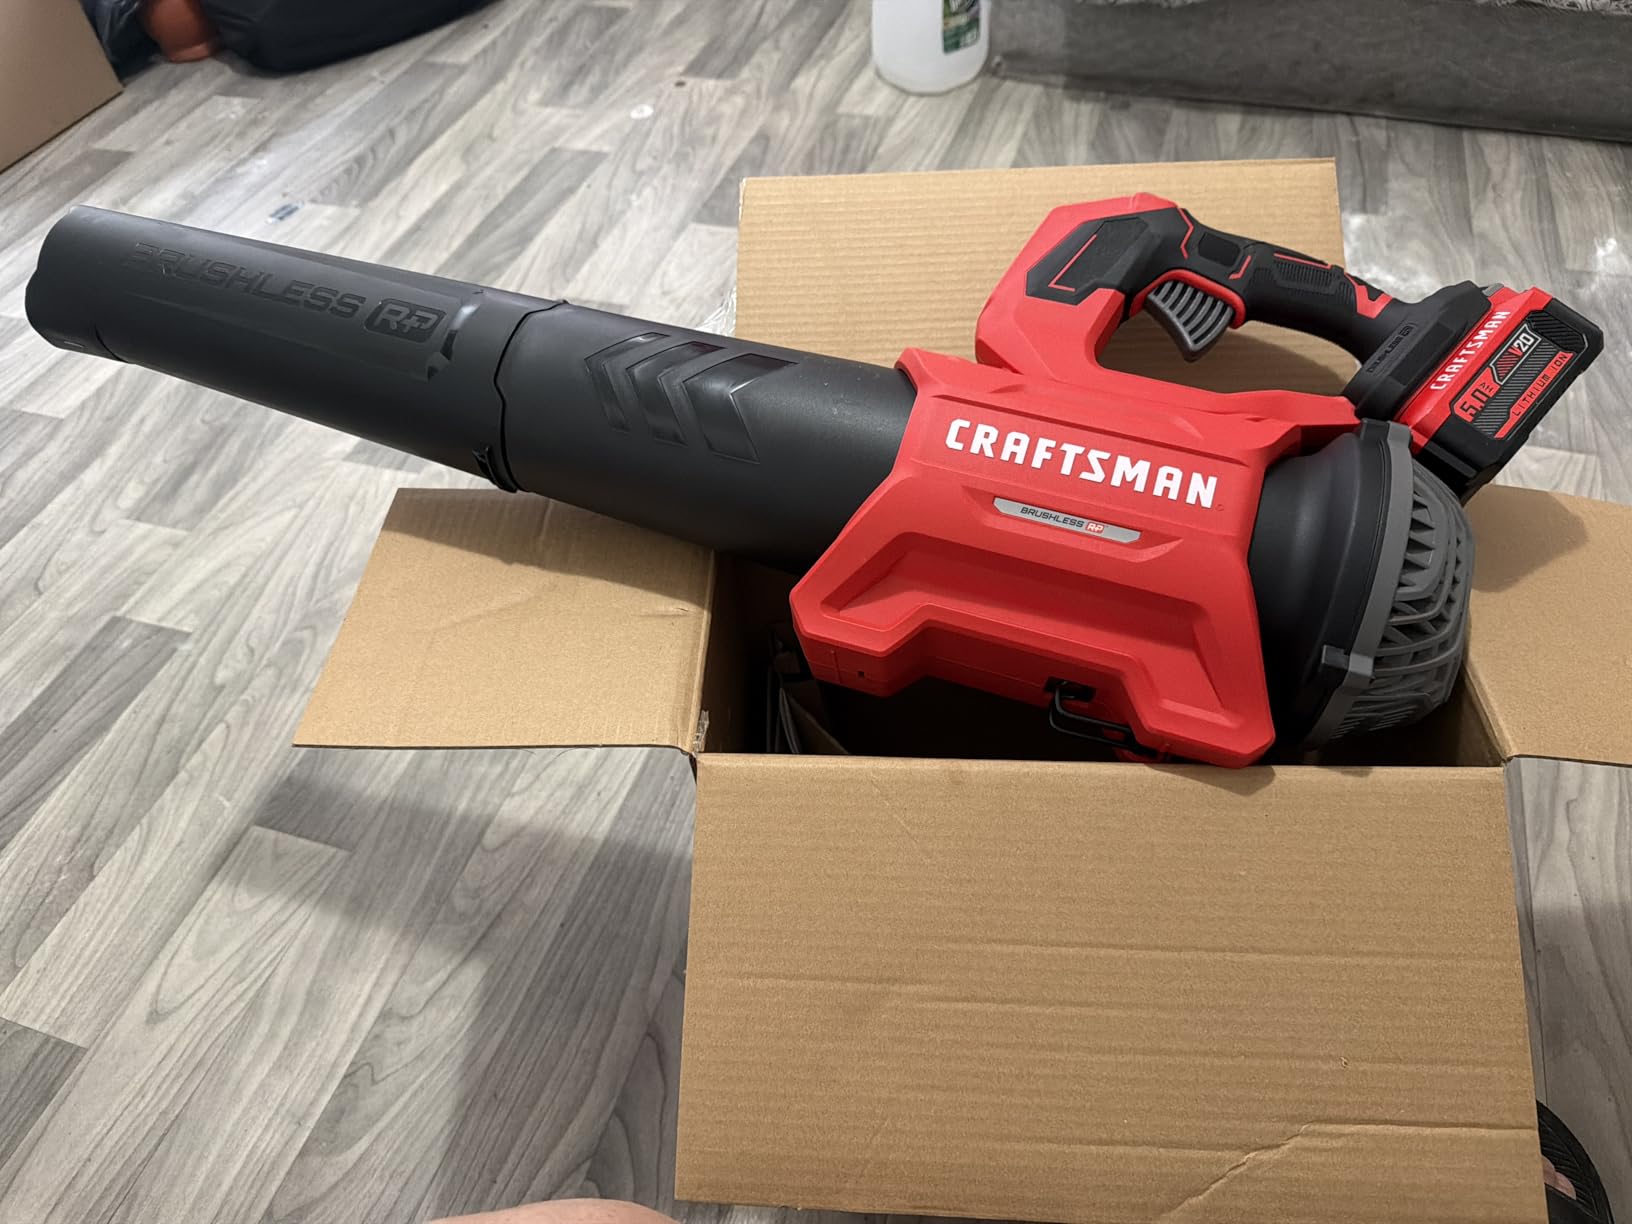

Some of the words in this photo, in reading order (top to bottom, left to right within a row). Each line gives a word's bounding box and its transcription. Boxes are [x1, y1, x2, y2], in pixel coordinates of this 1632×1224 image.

[127, 243, 366, 318] BRUSHLESS
[1430, 311, 1510, 391] CRAFTSMAN
[1460, 389, 1489, 417] 5.0
[1480, 382, 1498, 393] AH
[1512, 374, 1550, 416] LITHIUM
[1551, 355, 1567, 370] ION
[945, 418, 1217, 509] CRAFTSMAN
[1020, 506, 1085, 528] BRUSHLESS
[1086, 522, 1104, 534] RP
